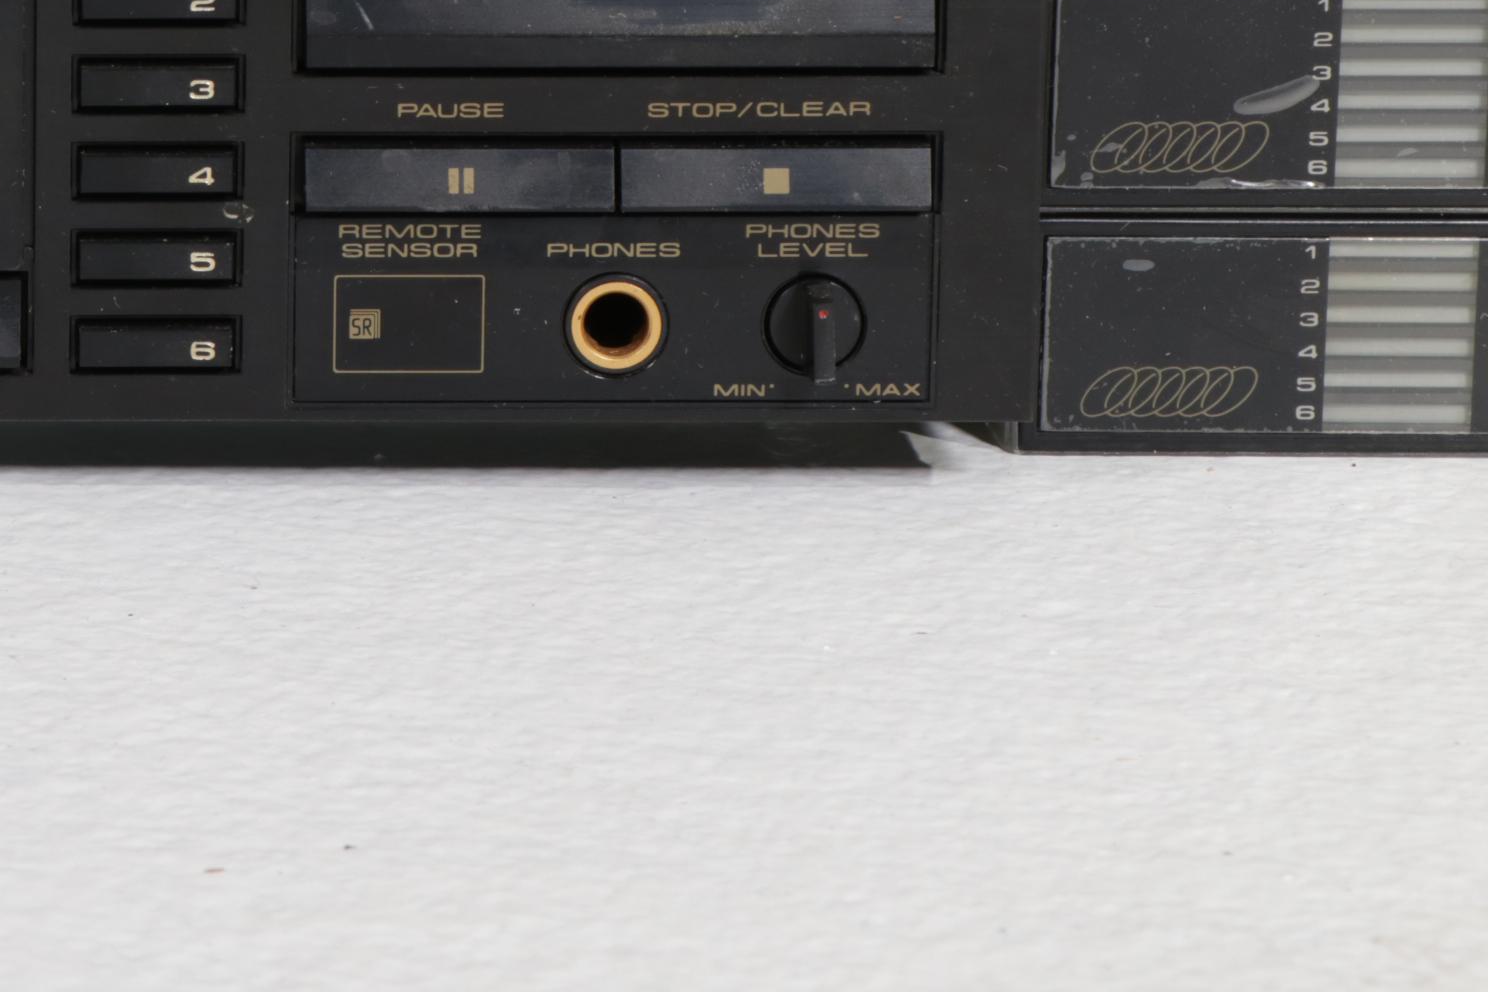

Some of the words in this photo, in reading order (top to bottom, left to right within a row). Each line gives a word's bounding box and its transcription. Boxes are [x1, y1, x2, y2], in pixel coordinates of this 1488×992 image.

[1312, 31, 1334, 47] 2
[1313, 66, 1332, 81] 3
[189, 79, 215, 100] 3
[397, 102, 505, 119] PAUSE
[647, 101, 871, 118] STOP/CLEAR
[1310, 98, 1331, 113] 4
[1308, 131, 1329, 147] 5
[1307, 159, 1328, 175] 6
[188, 166, 215, 186] 4
[338, 223, 482, 239] REMOTE
[745, 223, 881, 239] PHONES
[341, 242, 478, 259] SENSOR
[546, 242, 681, 258] PHONES
[757, 242, 869, 258] LEVEL
[1304, 245, 1317, 260] 1
[189, 251, 216, 272] 5
[1300, 278, 1321, 295] 2
[1299, 311, 1319, 328] 3
[190, 341, 216, 361] 6
[1297, 344, 1318, 359] 4
[713, 383, 766, 397] MIN
[855, 383, 921, 397] MAX
[1296, 376, 1317, 392] 5
[1295, 404, 1316, 421] 6
